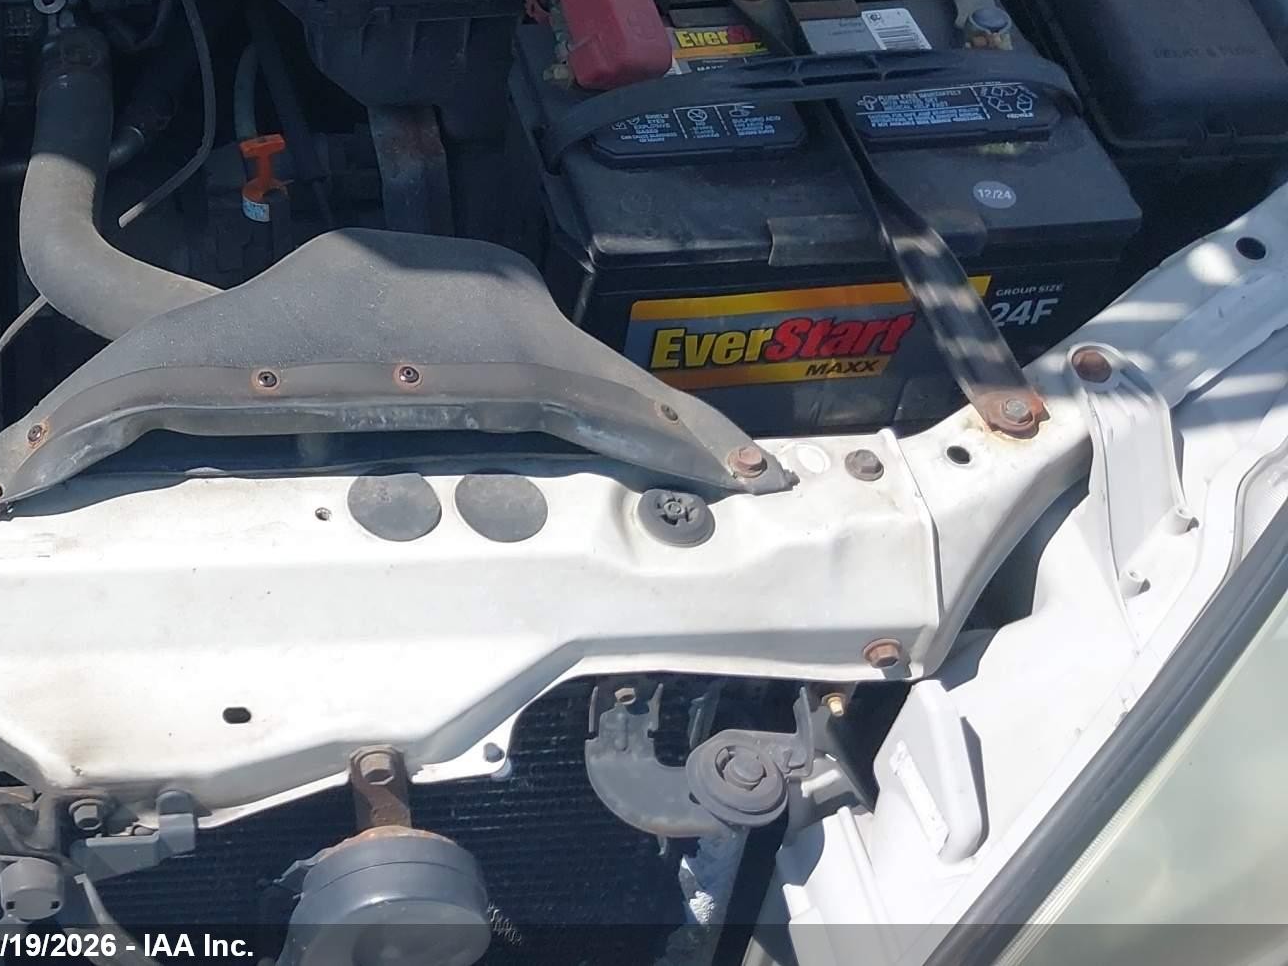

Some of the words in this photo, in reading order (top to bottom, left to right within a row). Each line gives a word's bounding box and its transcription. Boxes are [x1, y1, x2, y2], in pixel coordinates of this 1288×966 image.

[977, 188, 1012, 200] 12/24
[995, 286, 1037, 297] GROUP
[1038, 283, 1063, 294] SIZE
[991, 297, 1058, 328] 24F
[649, 310, 916, 371] EverStart
[805, 359, 880, 377] MAXX
